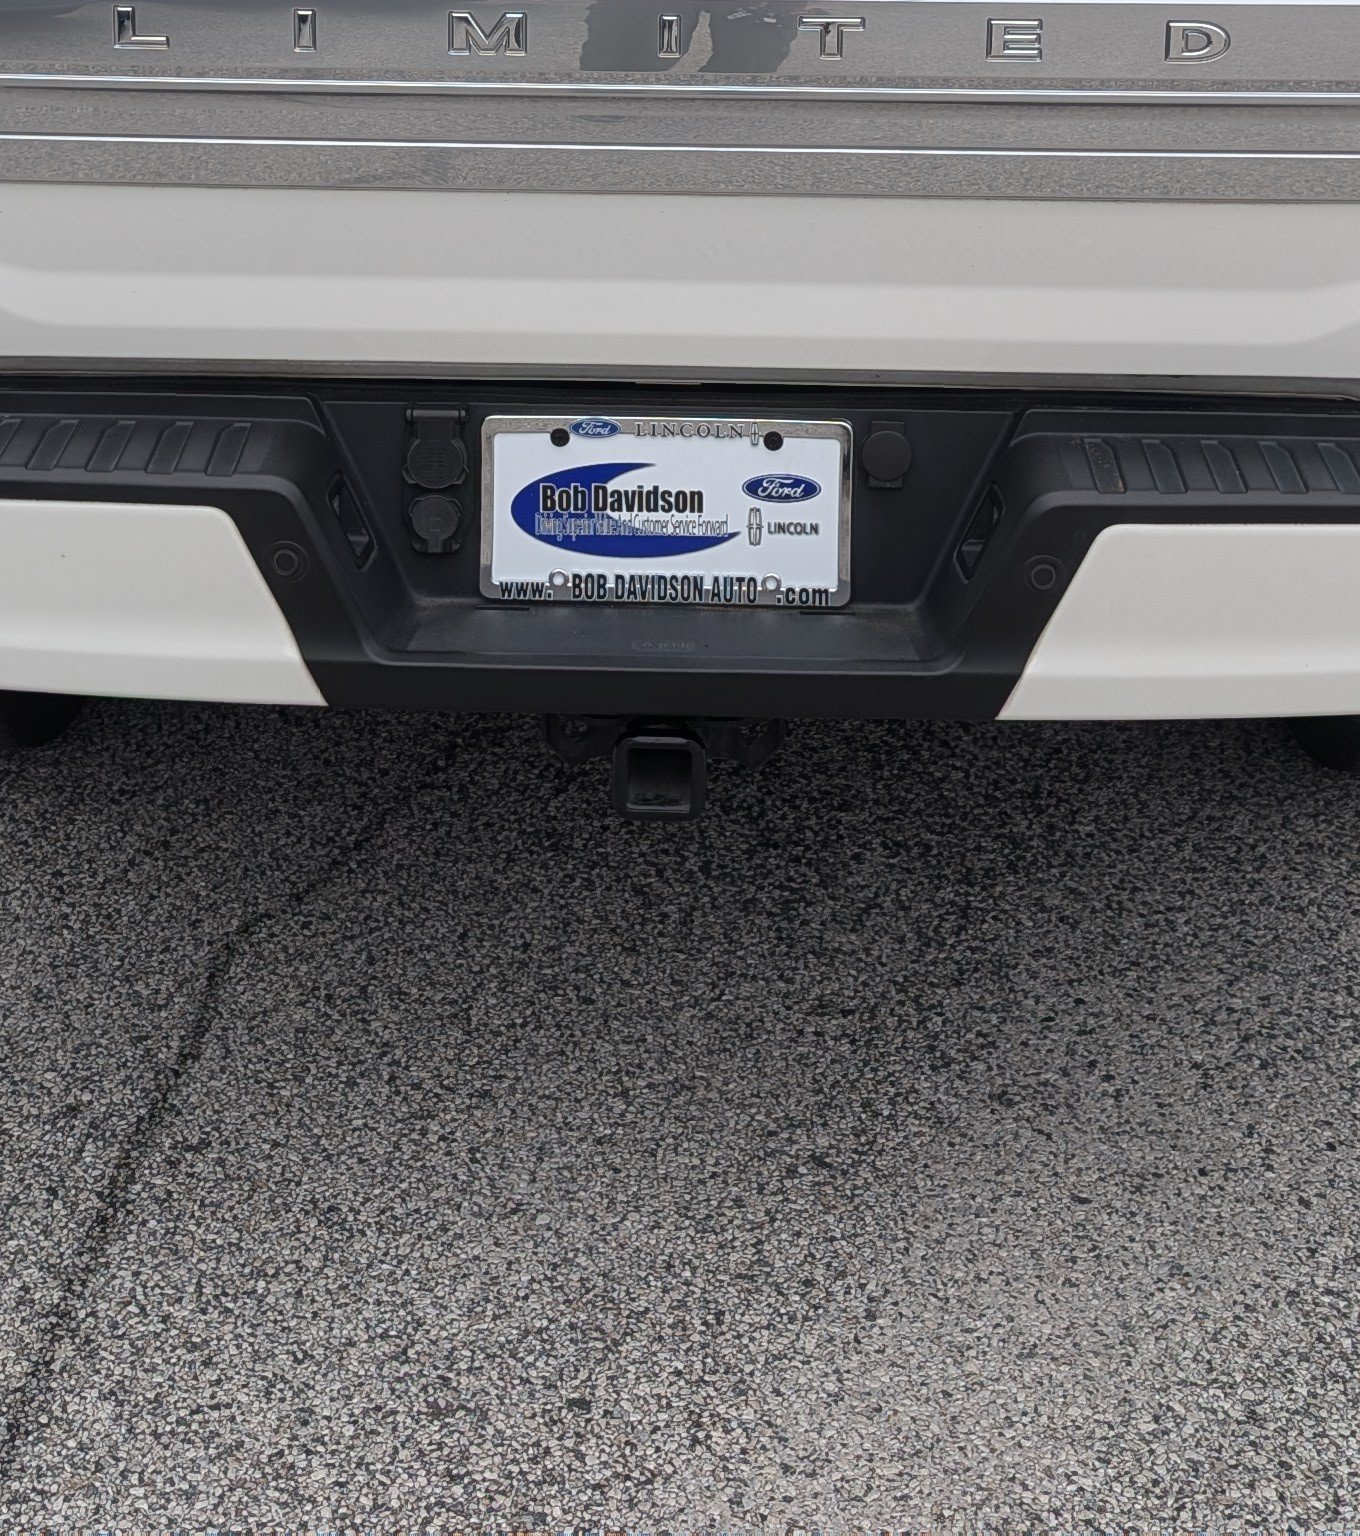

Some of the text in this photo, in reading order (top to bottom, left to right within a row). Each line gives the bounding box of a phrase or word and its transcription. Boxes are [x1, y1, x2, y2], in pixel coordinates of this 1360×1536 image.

[113, 3, 1232, 65] LIMITED
[577, 420, 743, 439] Ford LINCOLN
[541, 484, 704, 513] Bob Davidson
[757, 477, 805, 498] Ford
[634, 514, 669, 536] Customer
[670, 514, 697, 536] Service
[697, 514, 729, 536] Forward
[767, 521, 819, 536] LINCOLN
[571, 573, 608, 600] BOB
[614, 574, 704, 602] DAVIDSON
[711, 576, 758, 603] AUTO
